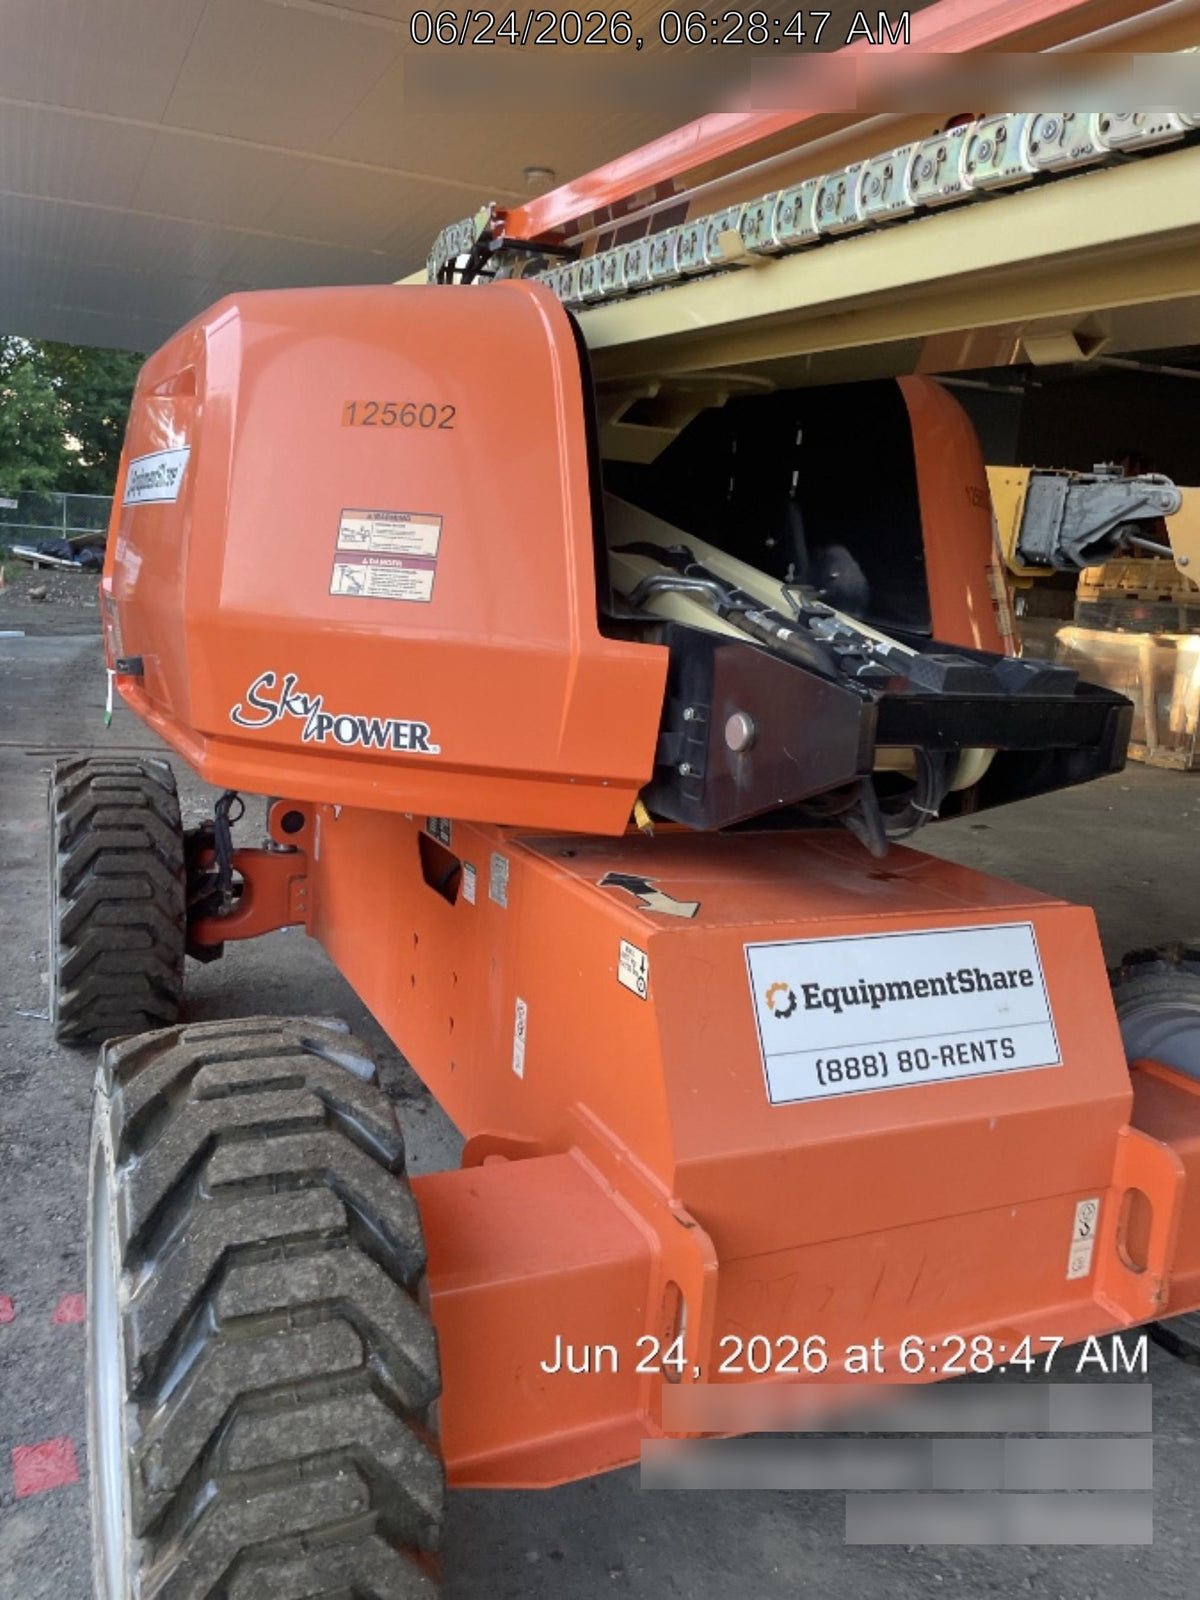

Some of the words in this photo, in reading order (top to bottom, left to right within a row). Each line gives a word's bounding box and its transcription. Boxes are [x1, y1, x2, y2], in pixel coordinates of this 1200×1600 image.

[346, 401, 456, 429] 125602
[802, 968, 1034, 1013] EquipmentShare
[816, 1052, 888, 1085] (888)
[898, 1038, 1016, 1073] 80-RENTS
